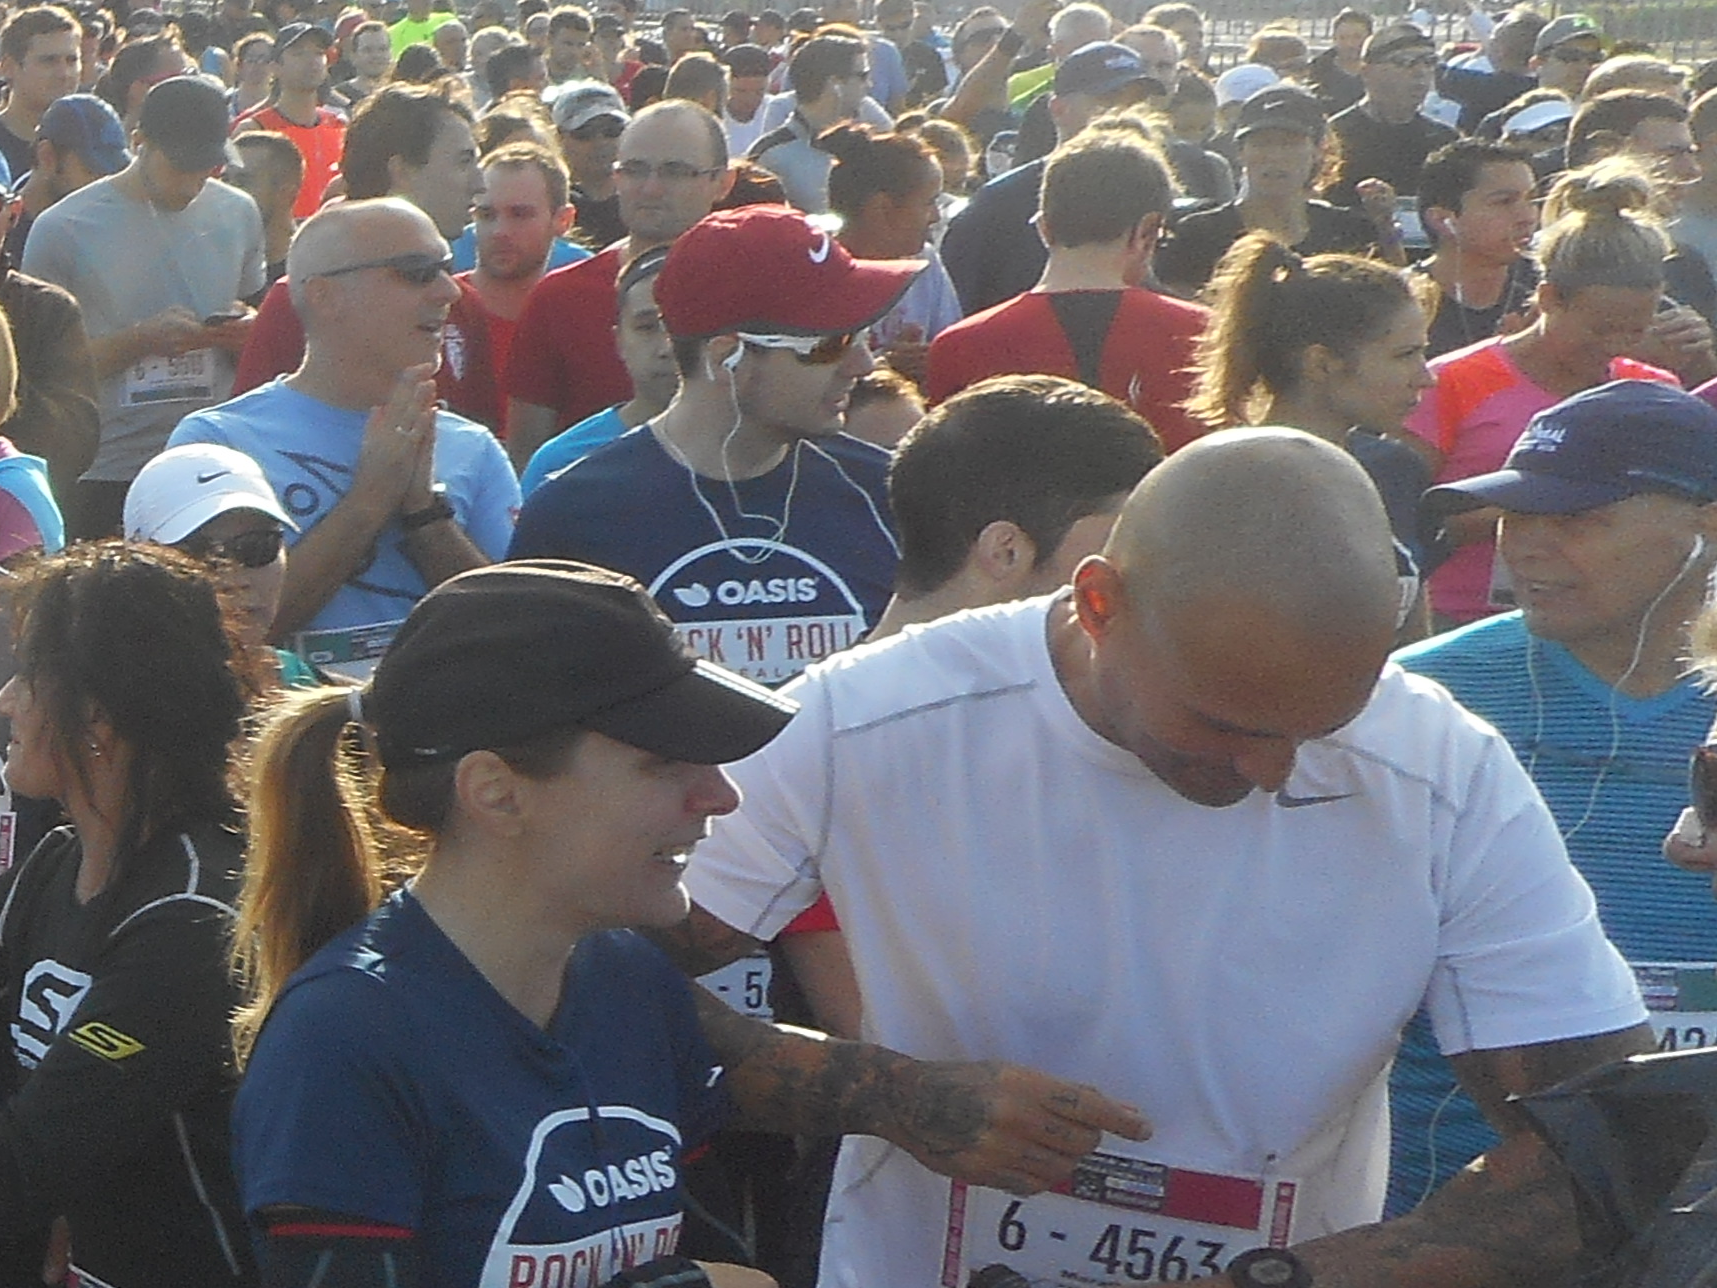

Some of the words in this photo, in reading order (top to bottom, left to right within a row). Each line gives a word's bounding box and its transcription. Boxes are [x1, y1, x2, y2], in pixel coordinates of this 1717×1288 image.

[716, 576, 818, 606] OASIS
[584, 1150, 677, 1207] OASIS
[998, 1200, 1027, 1251] 6
[1088, 1223, 1226, 1284] 4563
